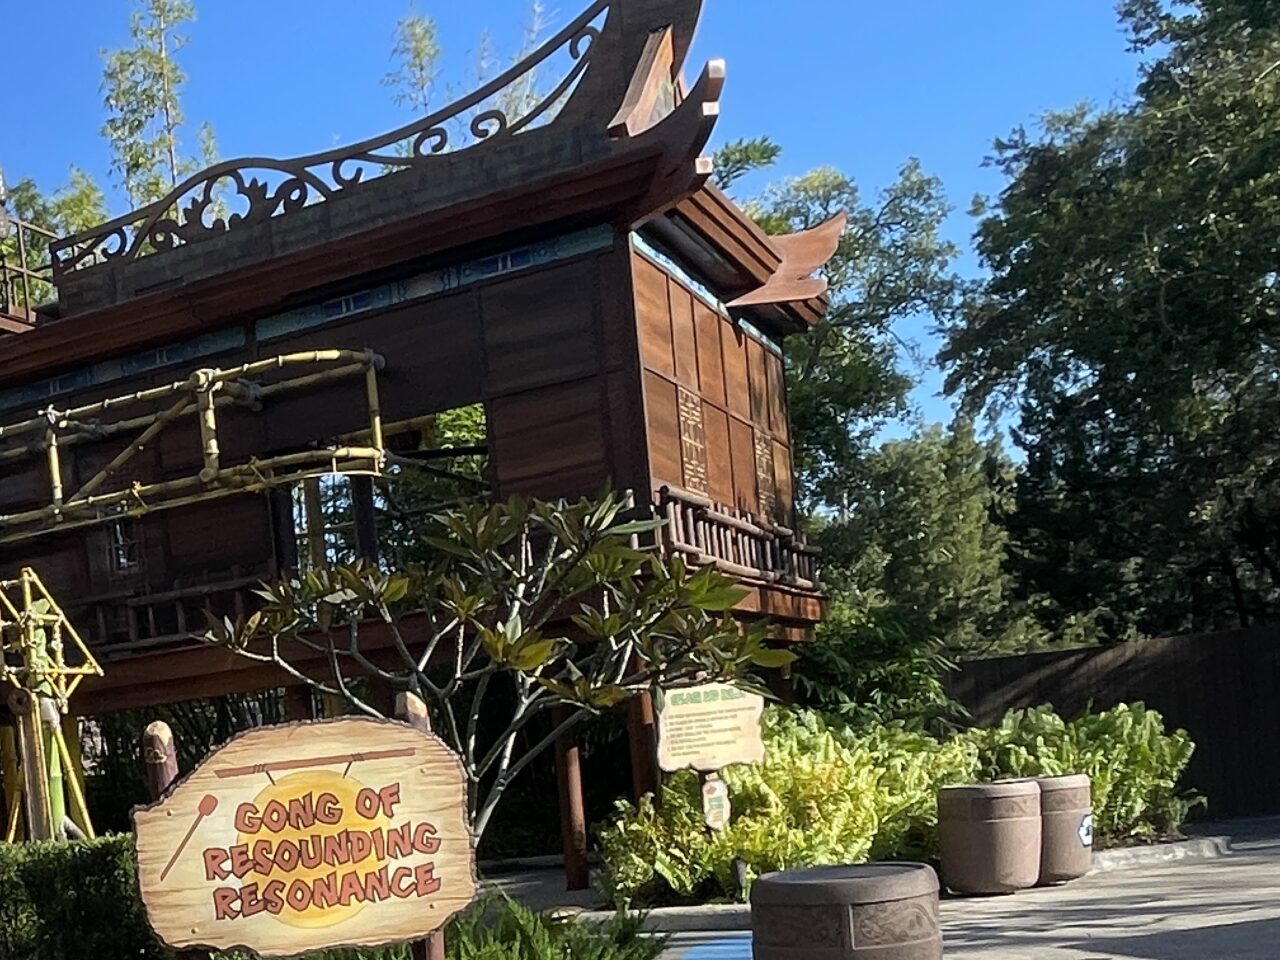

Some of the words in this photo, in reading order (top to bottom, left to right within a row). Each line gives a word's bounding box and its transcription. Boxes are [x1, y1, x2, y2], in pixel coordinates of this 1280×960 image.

[235, 791, 343, 834] GONG
[356, 783, 401, 819] OF
[203, 821, 442, 881] RESOUNDING
[213, 862, 442, 921] RESONANCE
